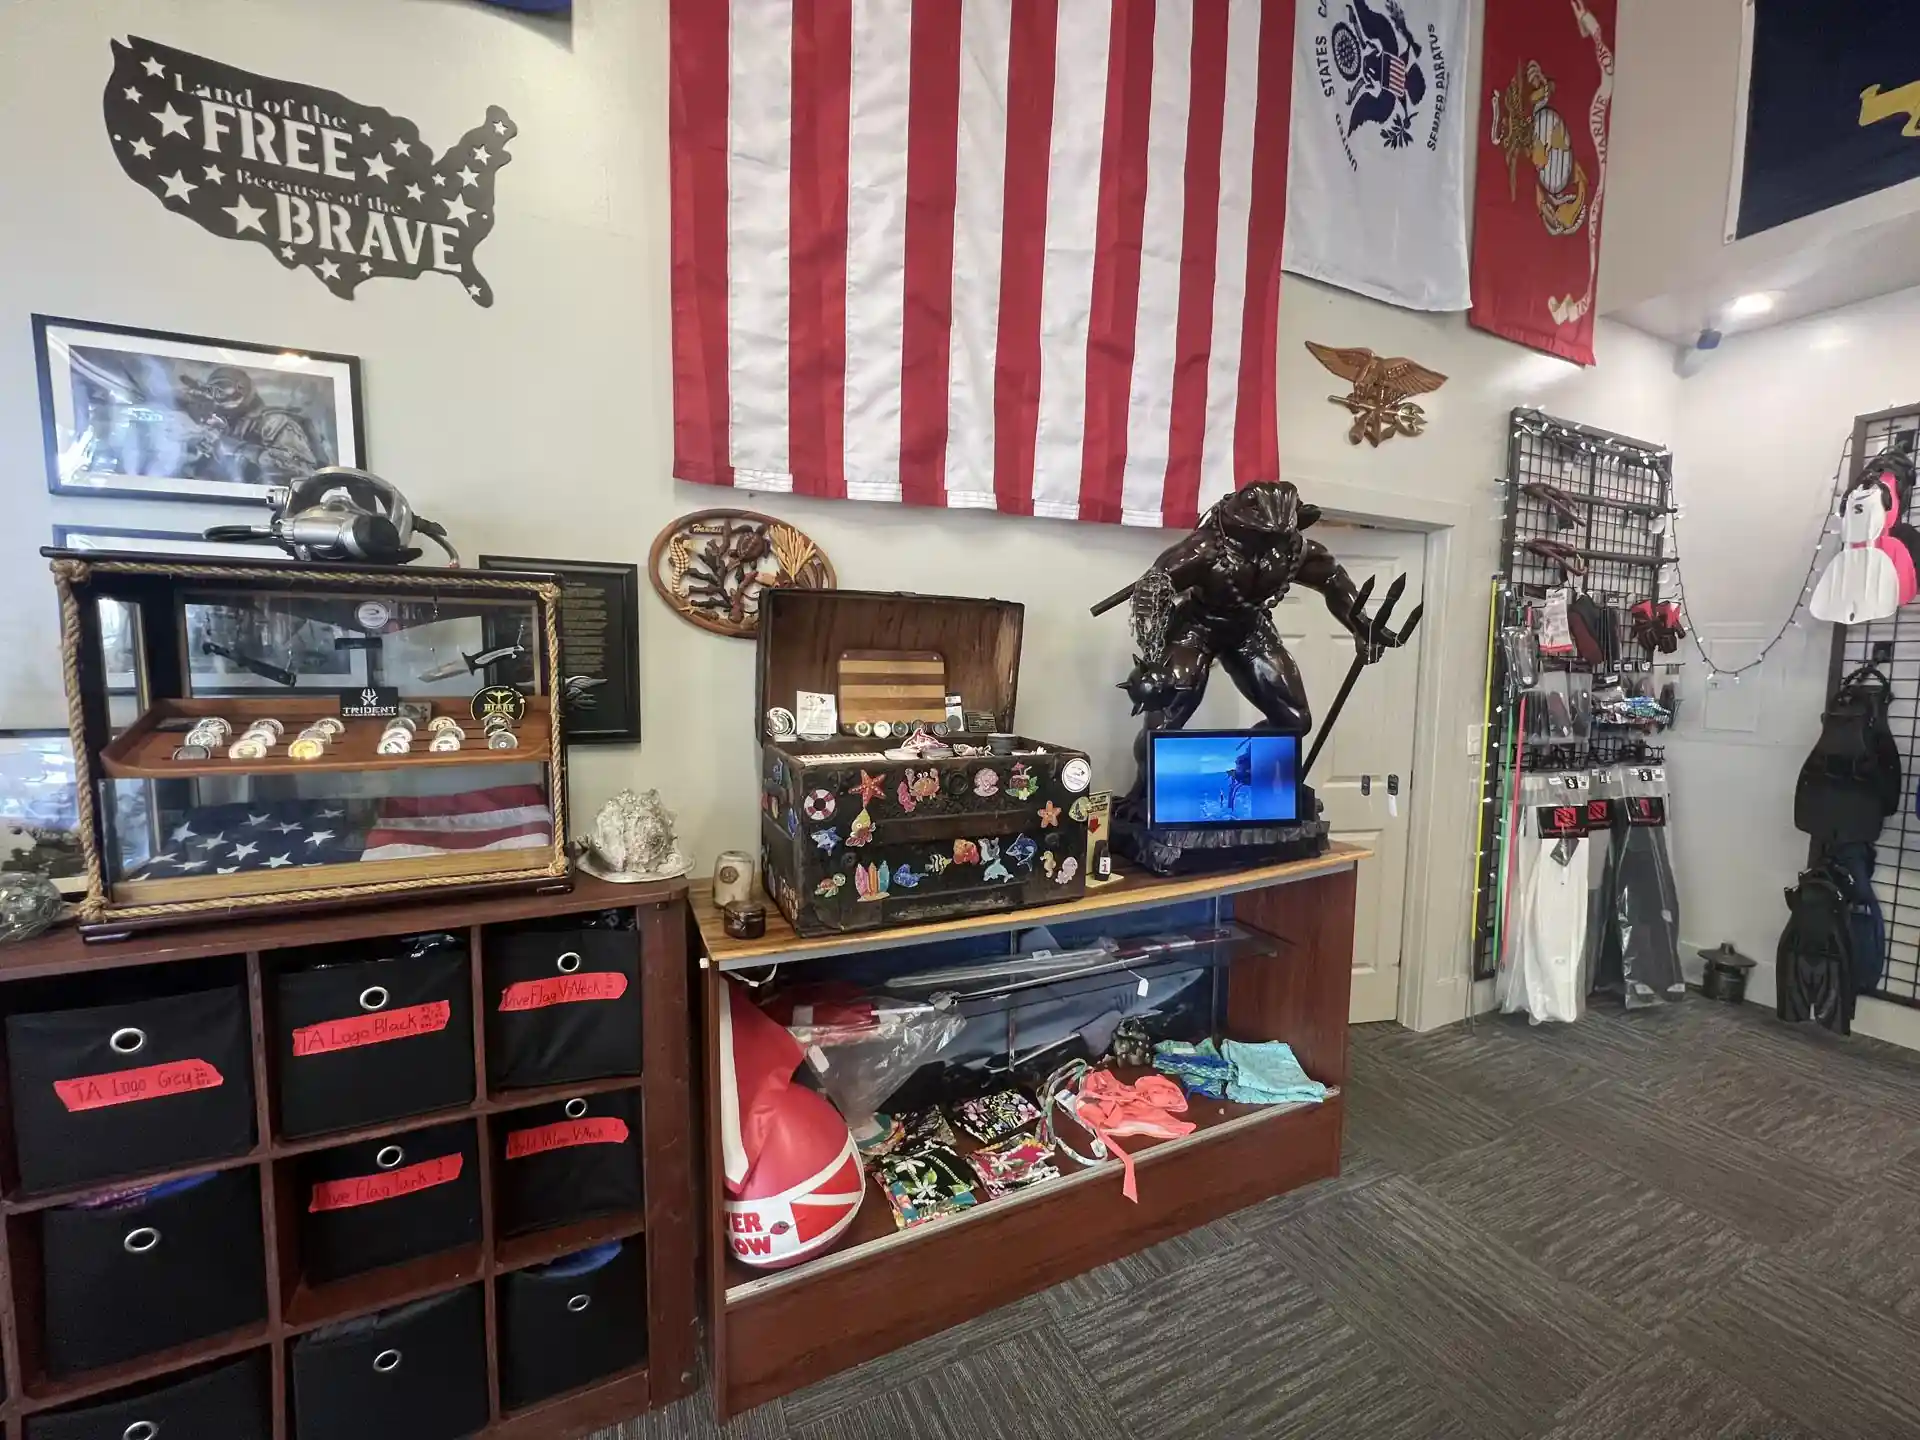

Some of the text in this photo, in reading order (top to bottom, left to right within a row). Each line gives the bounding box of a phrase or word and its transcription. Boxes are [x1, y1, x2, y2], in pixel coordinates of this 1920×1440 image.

[1315, 35, 1335, 98] STATES
[1426, 23, 1446, 152] SEMPER PARATUS
[174, 73, 348, 130] Land of the
[1591, 95, 1608, 164] MARINE
[200, 100, 357, 181] FREE
[236, 168, 402, 215] Because of the
[274, 192, 463, 273] BRAVE
[342, 706, 397, 714] TRIDENT
[331, 1027, 370, 1045] Logo
[374, 1012, 417, 1036] Black
[72, 1080, 103, 1104] TA
[112, 1078, 147, 1099] Logo
